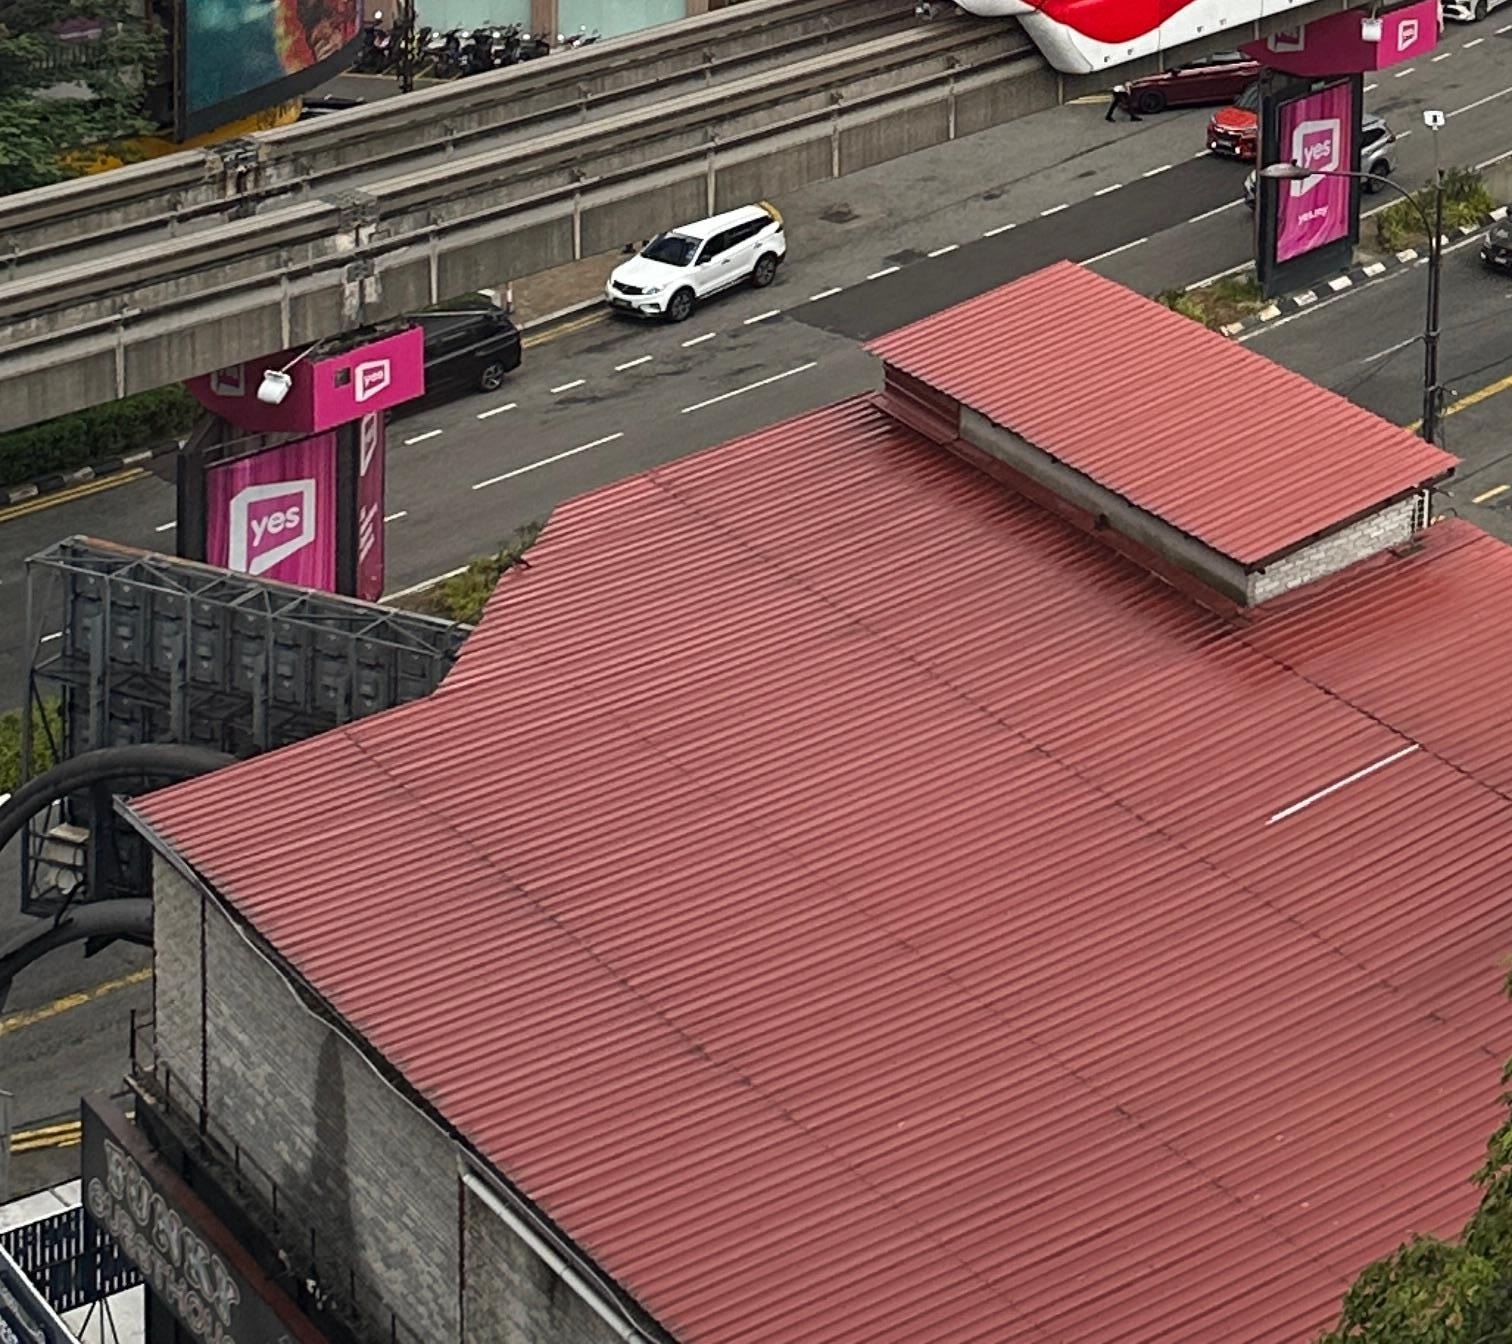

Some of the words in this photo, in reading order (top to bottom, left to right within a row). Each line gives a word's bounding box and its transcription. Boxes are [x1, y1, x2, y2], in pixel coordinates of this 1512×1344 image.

[1304, 139, 1332, 170] yes
[363, 370, 384, 393] yes
[251, 505, 301, 548] yes
